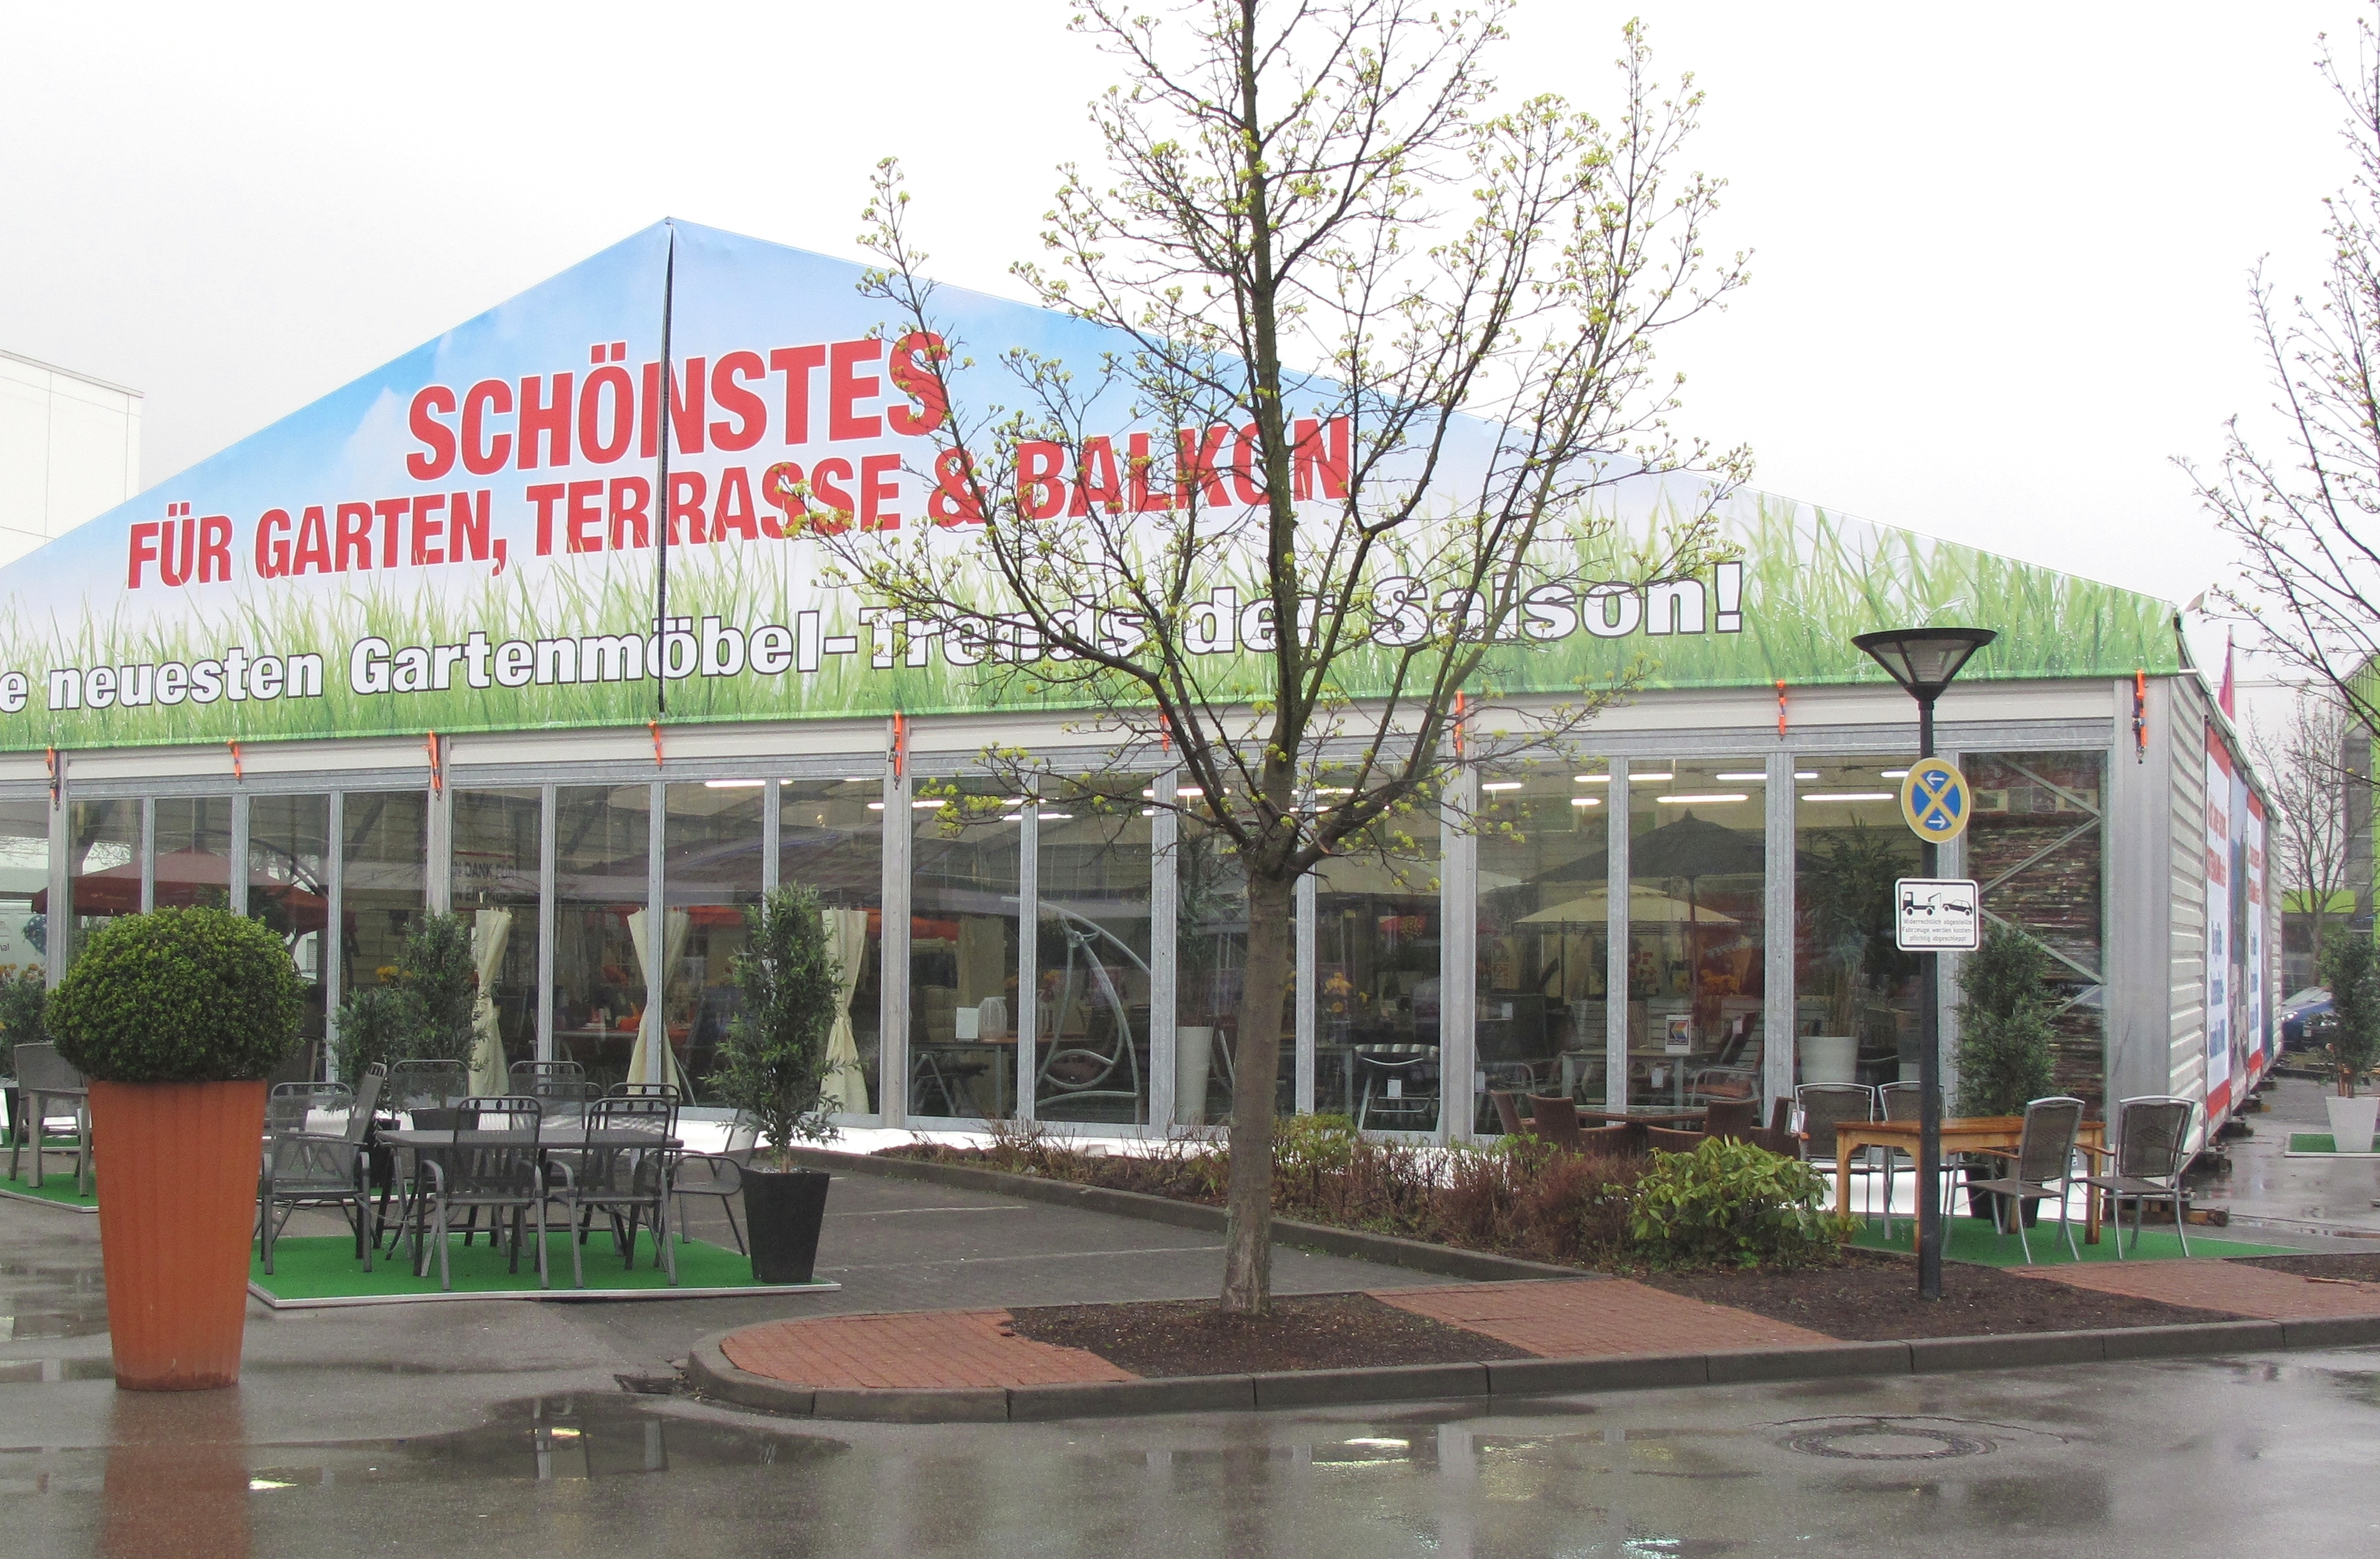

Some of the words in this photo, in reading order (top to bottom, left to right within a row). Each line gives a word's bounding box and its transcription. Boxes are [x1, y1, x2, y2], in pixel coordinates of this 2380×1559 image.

[406, 331, 949, 482] SCHÖNSTES
[128, 502, 233, 589] FÜR
[255, 489, 508, 577] GARTEN,
[526, 453, 902, 557] TERRASSE
[928, 447, 989, 528] &
[1017, 416, 1349, 522] BALKON
[48, 646, 324, 711] neuesten
[1181, 585, 1336, 656] der
[1371, 561, 1743, 647] Saison!
